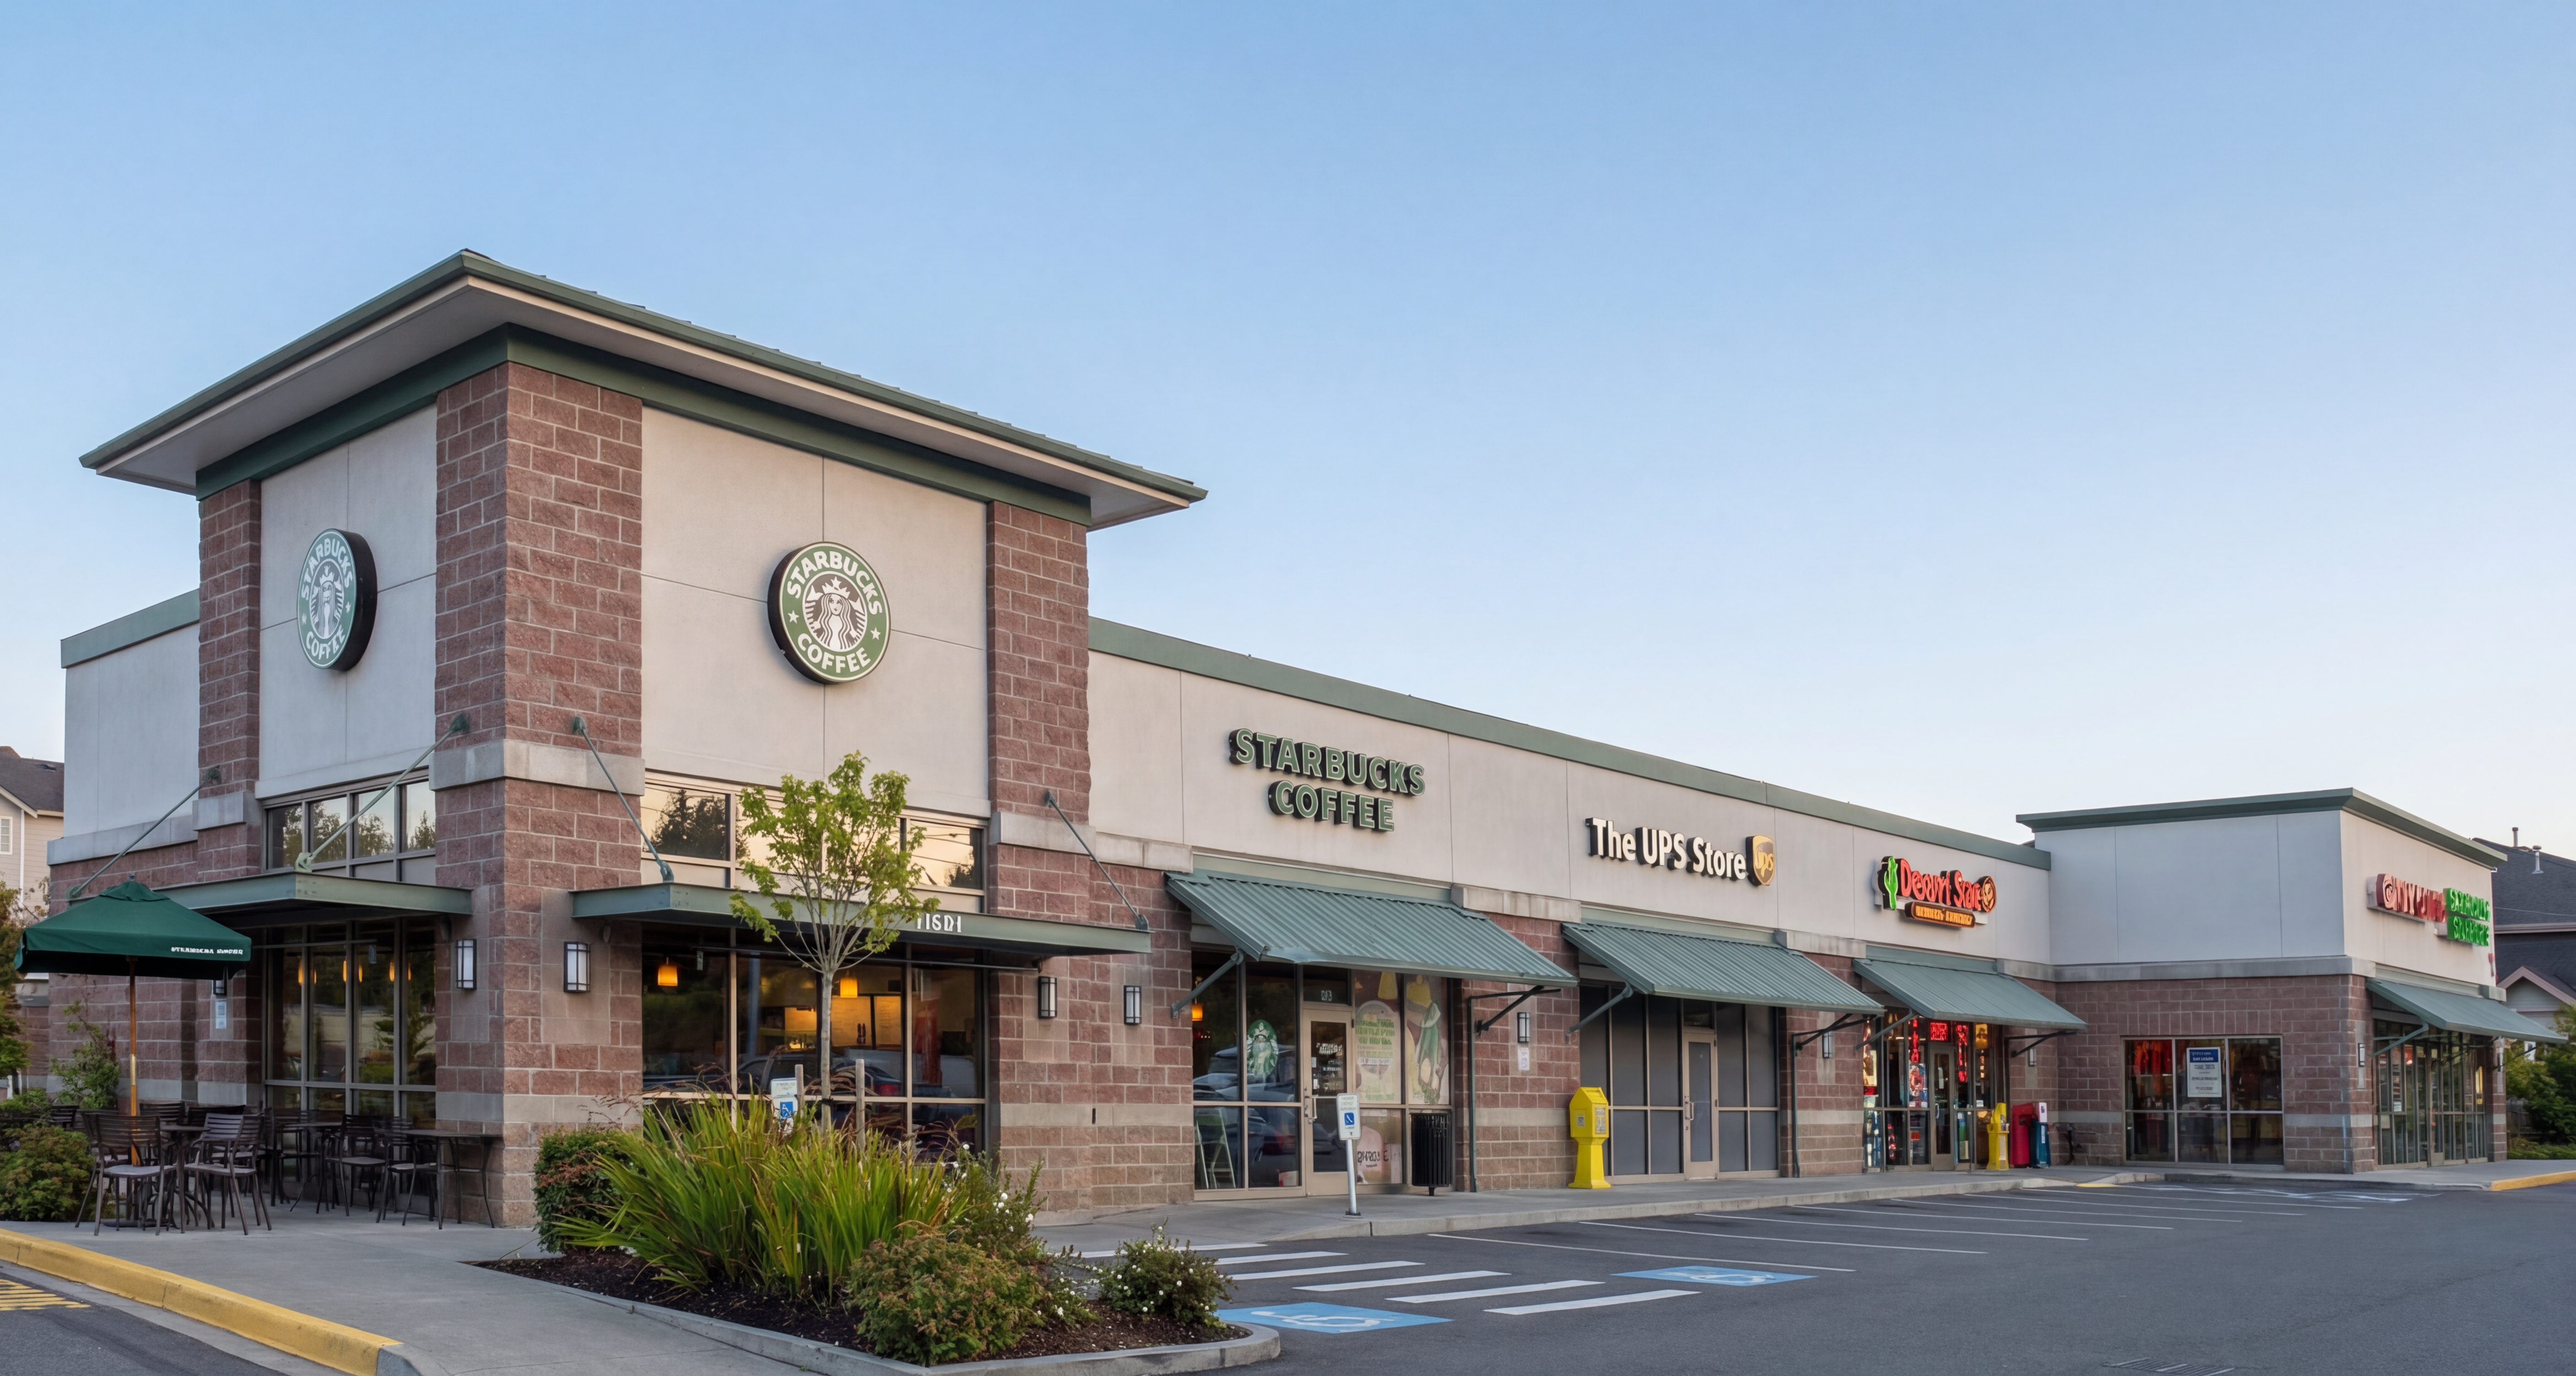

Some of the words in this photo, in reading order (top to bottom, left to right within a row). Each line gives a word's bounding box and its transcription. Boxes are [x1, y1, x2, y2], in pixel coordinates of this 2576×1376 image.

[301, 538, 353, 600] STARBUCKS
[787, 550, 883, 615] STARBUCKS
[306, 624, 345, 660] COFFEE
[797, 633, 871, 673] COFFEE
[1235, 728, 1425, 796] STARBUCKS
[1274, 780, 1394, 832] COFFEE
[1592, 817, 1636, 861] The
[1642, 827, 1687, 870] UPS
[1692, 836, 1747, 880] Store
